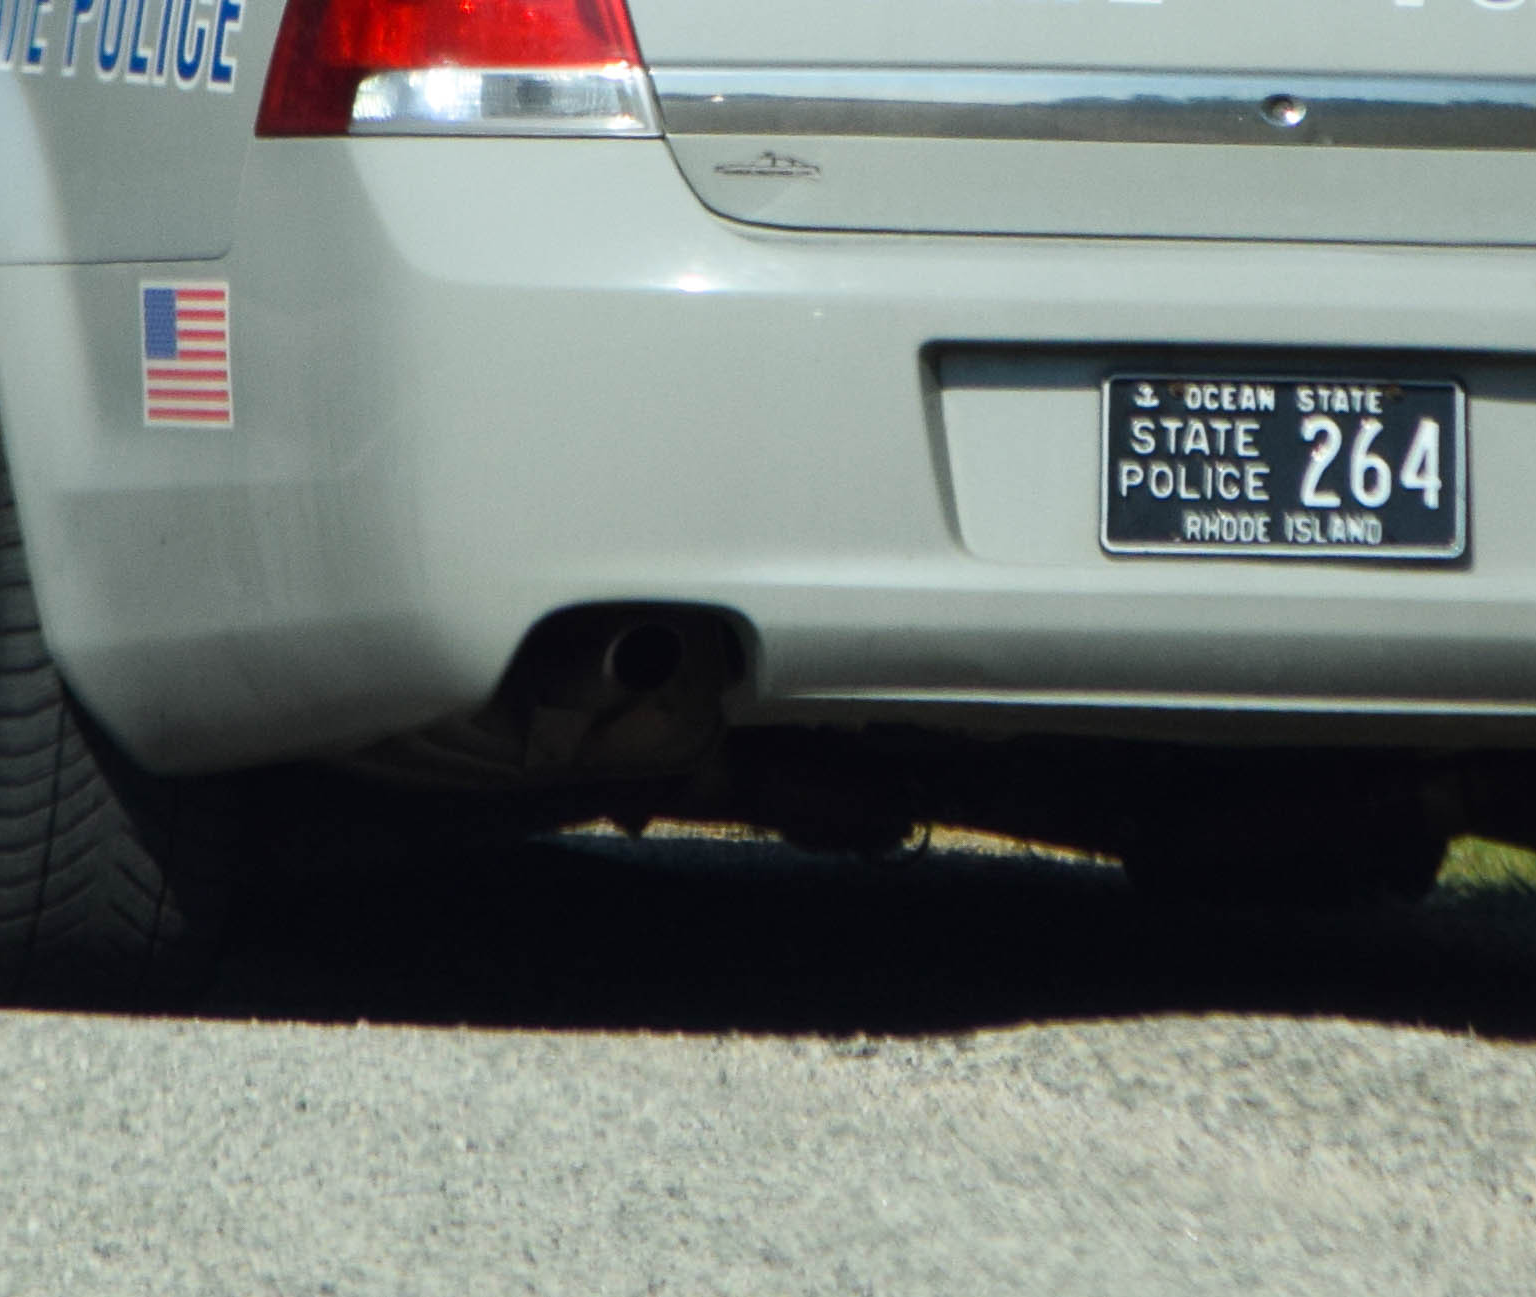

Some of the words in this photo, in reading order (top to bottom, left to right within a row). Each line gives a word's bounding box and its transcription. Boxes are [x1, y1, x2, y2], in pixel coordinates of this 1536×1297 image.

[1184, 385, 1276, 412] OCEAN
[1296, 386, 1383, 413] STATE
[1130, 418, 1260, 457] STATE
[1118, 462, 1271, 502] POLICE
[1300, 416, 1442, 510] 264
[1183, 512, 1271, 543] RHODE
[1284, 513, 1383, 545] ISLAND
